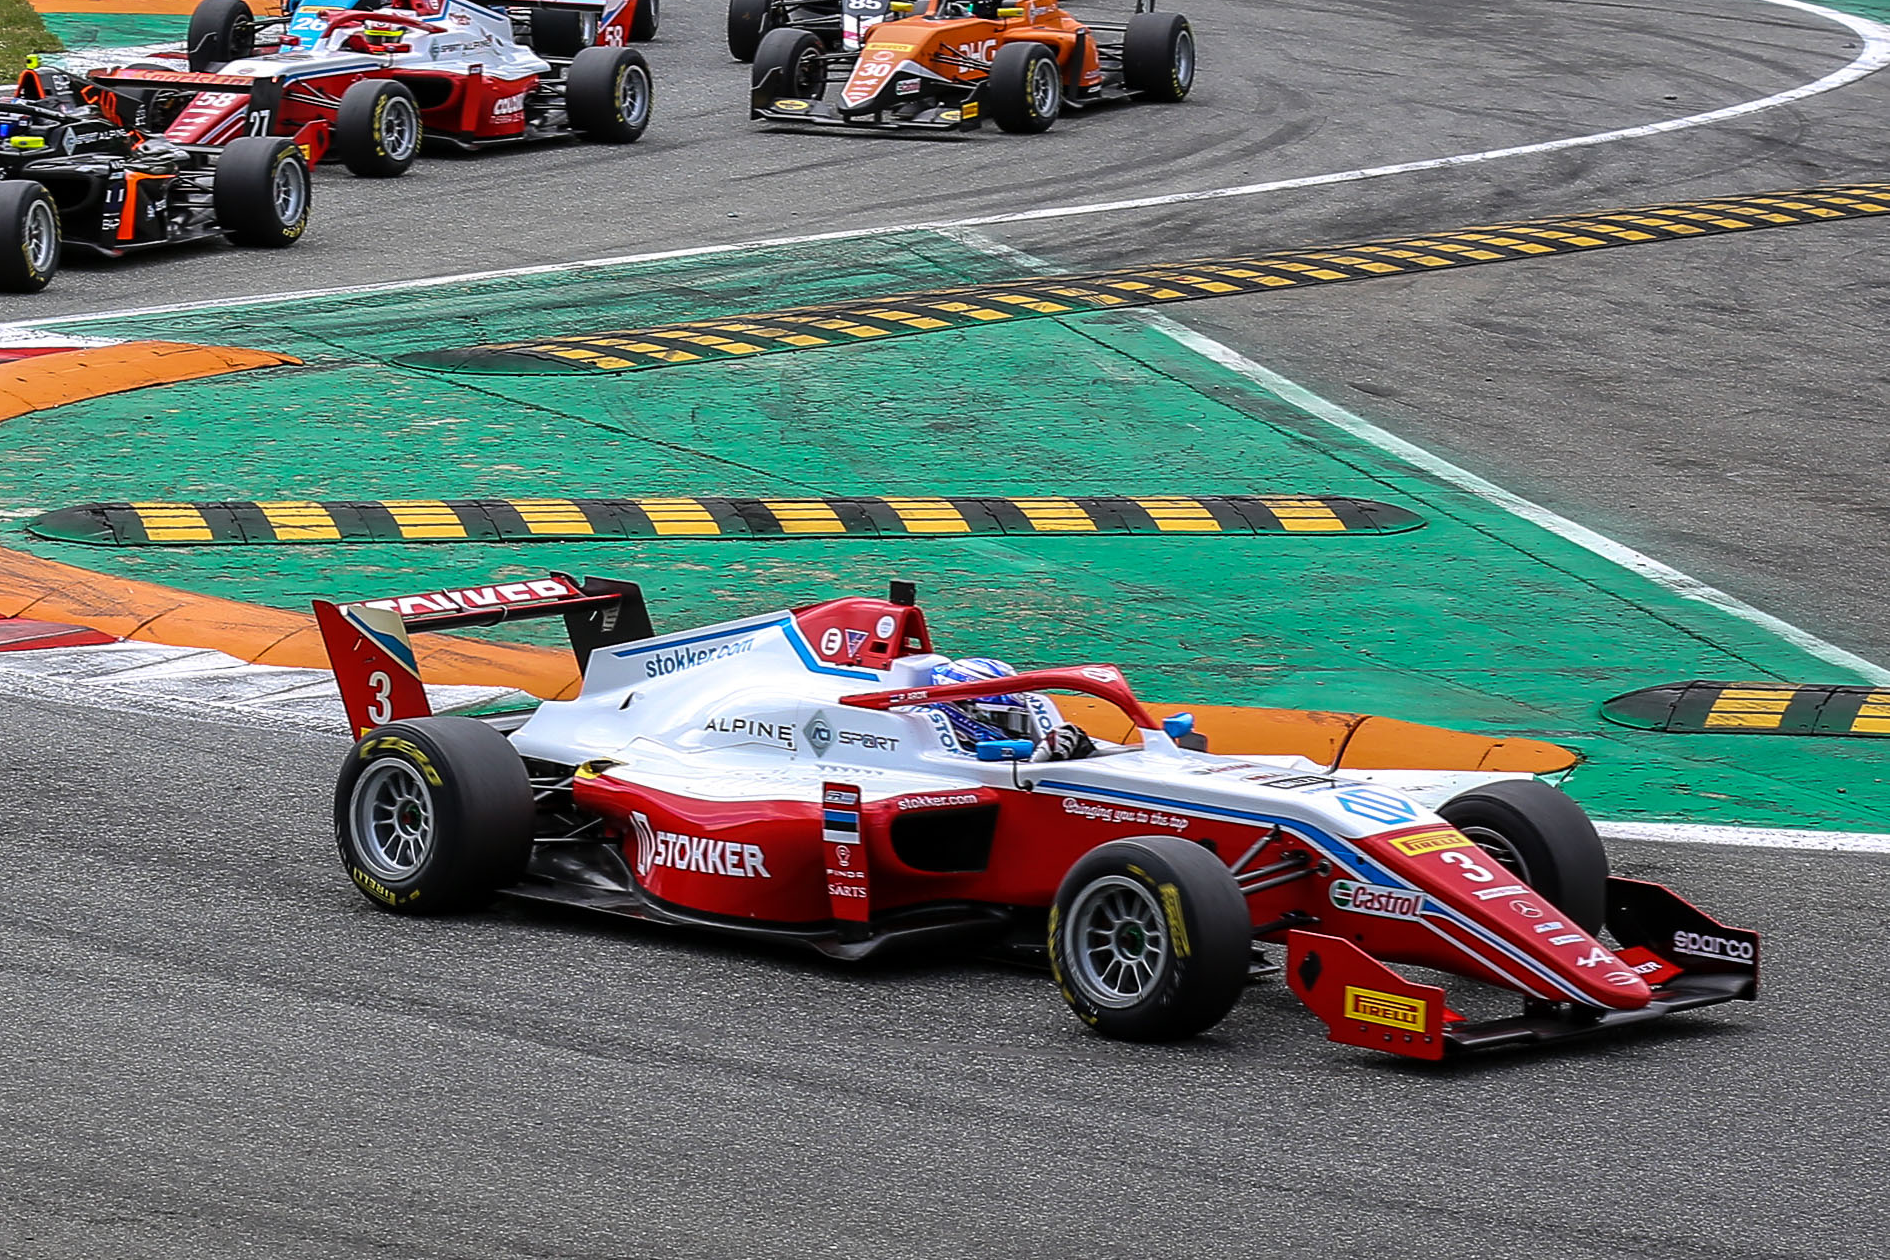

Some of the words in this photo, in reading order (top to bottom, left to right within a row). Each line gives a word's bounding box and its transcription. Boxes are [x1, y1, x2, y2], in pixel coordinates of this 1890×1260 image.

[292, 17, 328, 31] 26
[604, 25, 624, 48] 58
[859, 63, 891, 77] 30
[195, 92, 237, 107] 58
[249, 109, 271, 138] 27
[645, 637, 754, 679] stokker.com
[367, 670, 393, 724] 3
[704, 718, 793, 741] ALPINE
[838, 730, 900, 752] SPORT
[897, 792, 978, 811] stokker.com
[655, 830, 772, 878] STOKKER
[1401, 833, 1466, 851] PIRELLI
[1440, 851, 1494, 882] 3
[352, 866, 397, 906] PIRELLI
[1352, 886, 1422, 917] Castrol
[1673, 929, 1754, 959] sparco
[1357, 997, 1421, 1025] PIRELLI
